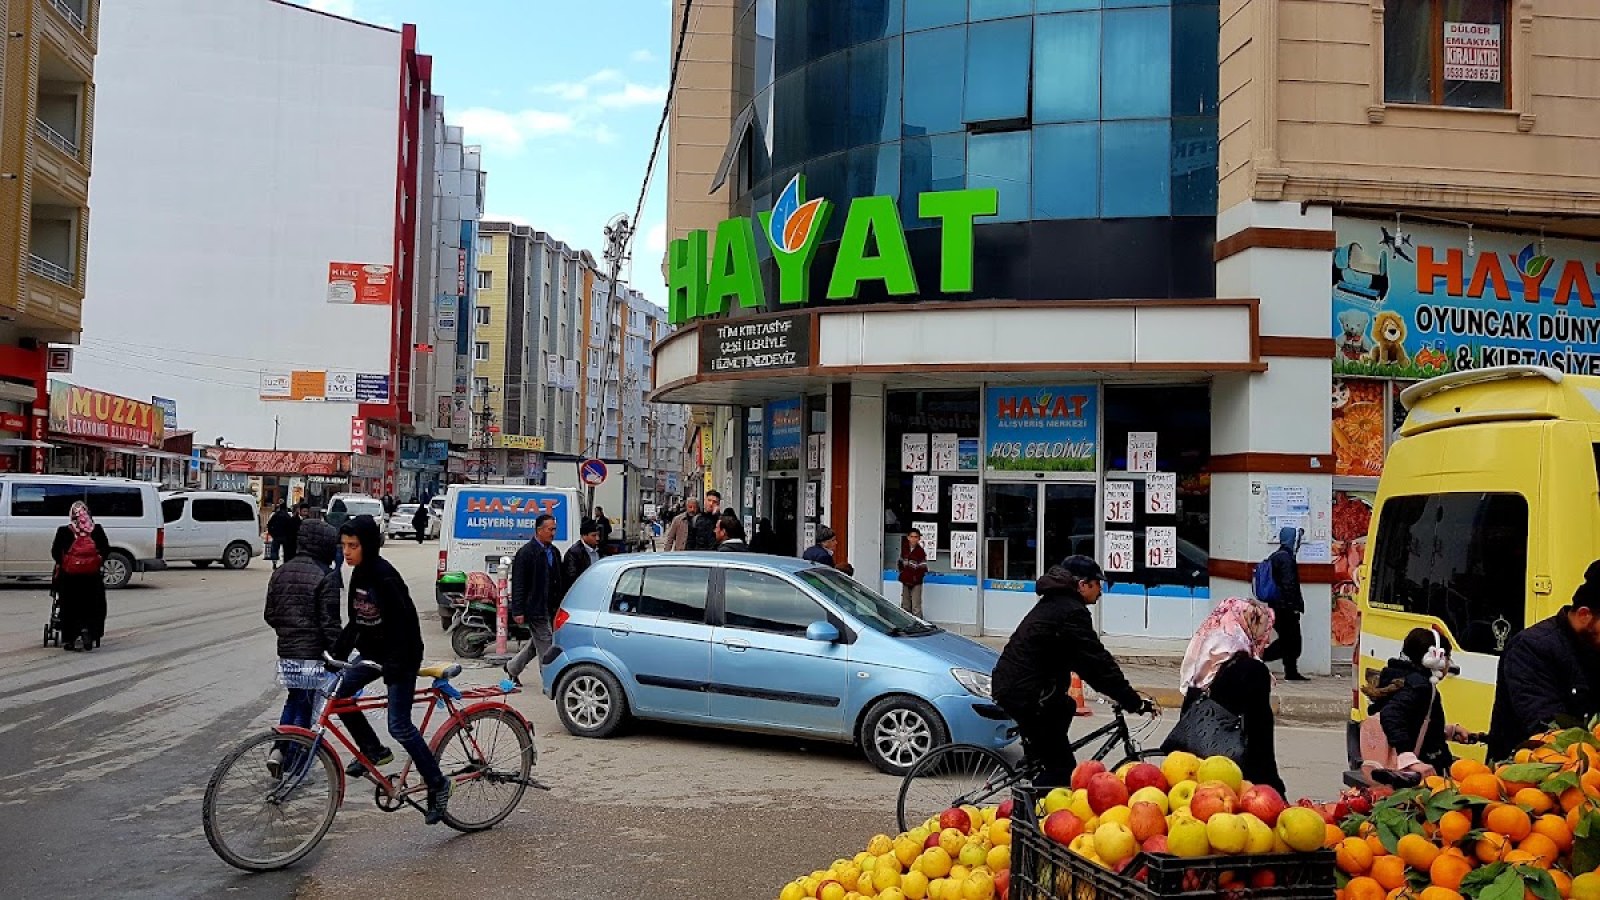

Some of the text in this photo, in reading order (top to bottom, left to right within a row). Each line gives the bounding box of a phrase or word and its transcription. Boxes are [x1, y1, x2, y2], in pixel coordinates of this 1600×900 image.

[1446, 37, 1498, 47] EMLAKTAN
[667, 174, 998, 325] HAYAT
[1416, 244, 1600, 308] HAYA
[1416, 305, 1533, 340] OYUNCAK
[71, 387, 152, 428] MUZZY
[998, 389, 1090, 418] HAYAT
[990, 436, 1094, 463] HOŞ GELDİNİZ
[467, 496, 559, 514] HAYAT
[467, 515, 514, 530] ALIŞVERİŞ
